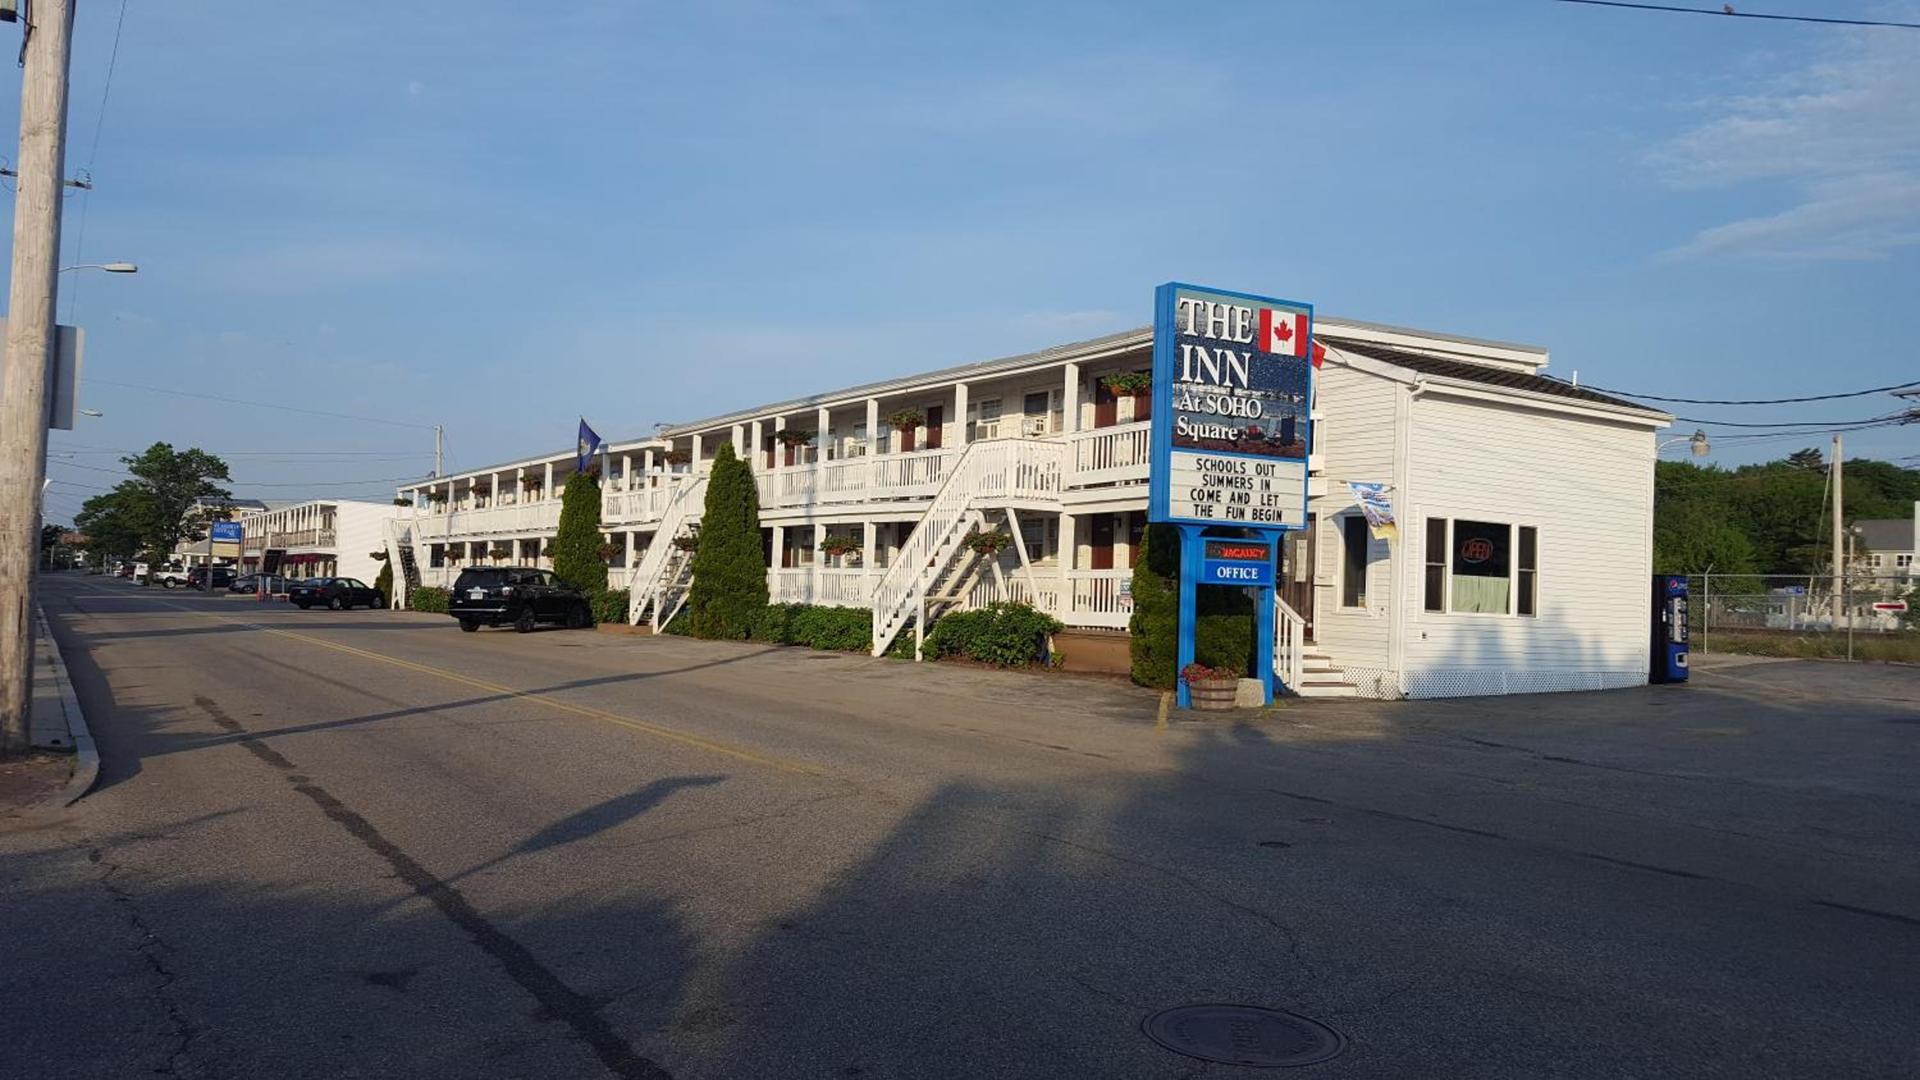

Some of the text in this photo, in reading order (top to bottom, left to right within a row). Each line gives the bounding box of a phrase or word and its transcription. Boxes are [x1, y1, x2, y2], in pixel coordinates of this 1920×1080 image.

[1179, 297, 1253, 344] THE
[1180, 344, 1251, 389] INN
[1179, 391, 1262, 417] At SOHO
[1177, 416, 1239, 440] Square
[1196, 458, 1276, 476] SCHOOLS OUT
[1202, 474, 1271, 490] SUMMERS IN
[1190, 488, 1279, 506] COME AND LET
[1194, 504, 1282, 522] THE FUN BEGIN
[1223, 546, 1265, 558] VACANCY
[1216, 566, 1259, 580] OFFICE
